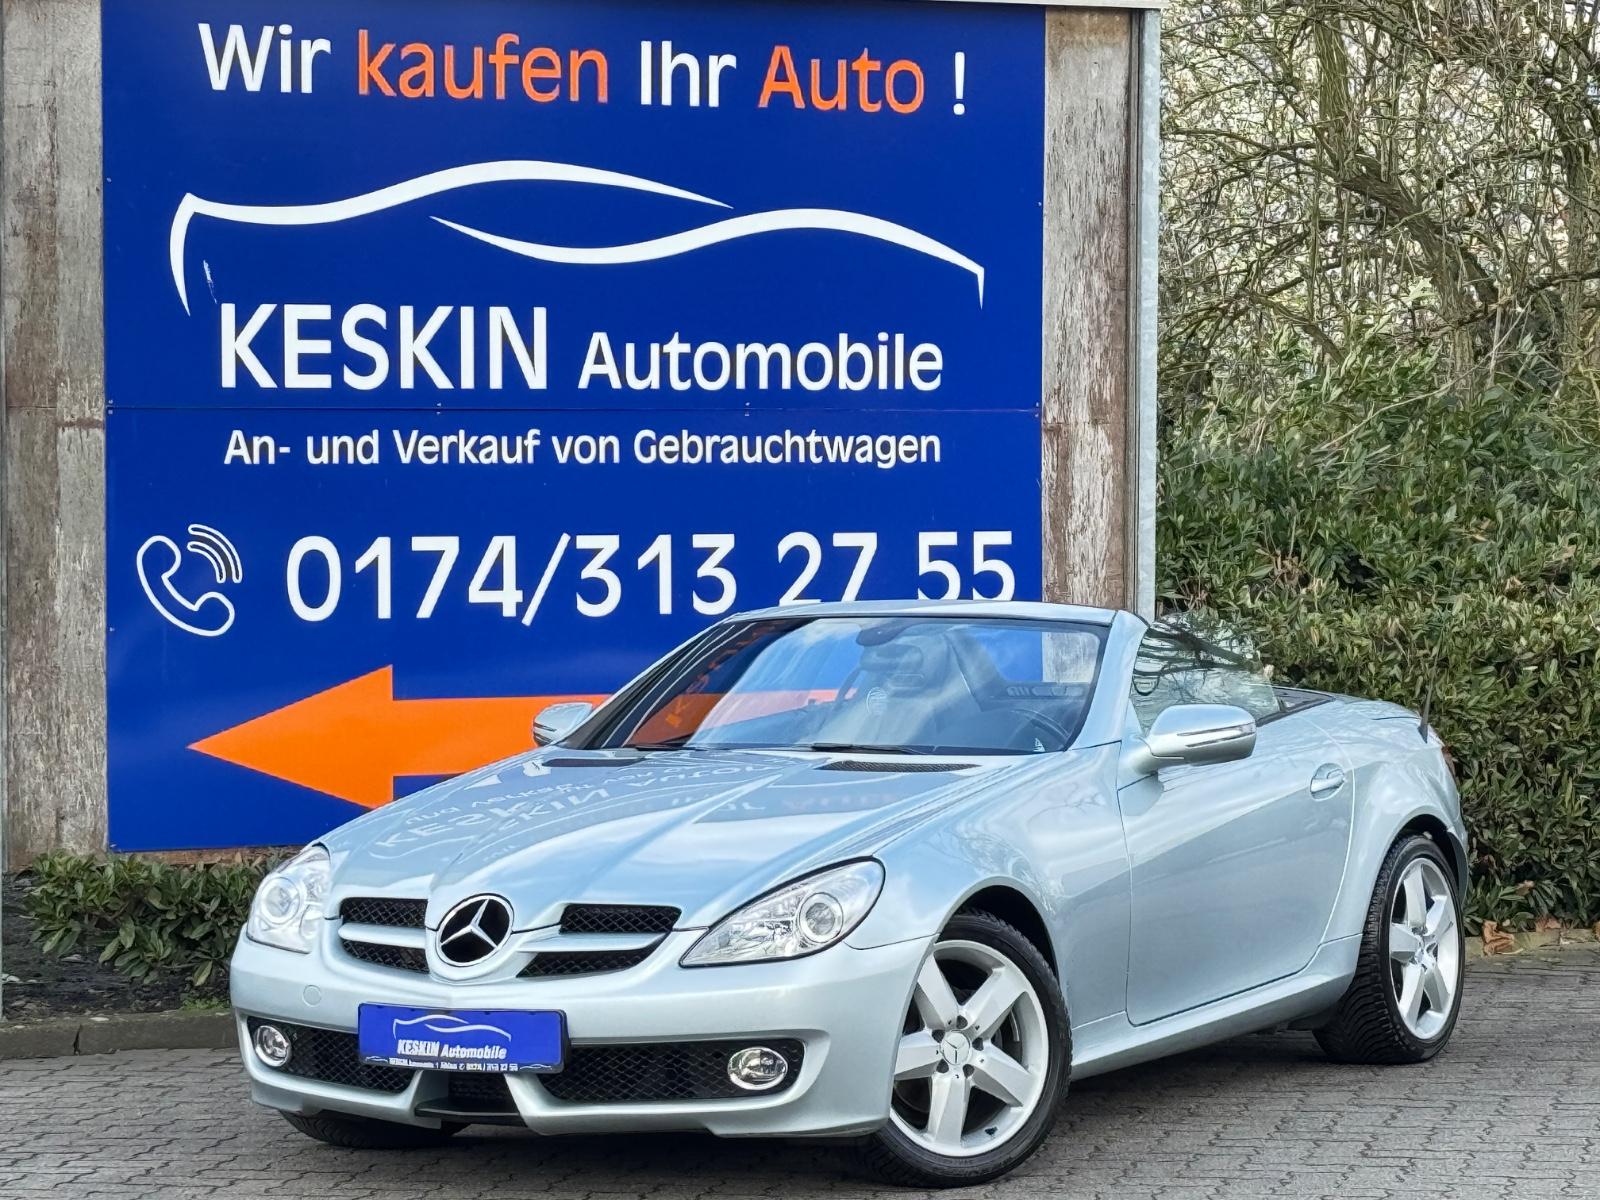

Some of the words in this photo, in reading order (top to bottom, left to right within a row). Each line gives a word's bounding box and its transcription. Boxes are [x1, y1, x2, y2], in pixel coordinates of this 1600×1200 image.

[198, 23, 332, 94] Wir
[358, 29, 609, 104] kaufen
[640, 41, 737, 108] Ihr
[758, 46, 926, 114] Auto
[952, 51, 966, 116] !
[220, 302, 547, 390] KESKIN
[577, 331, 944, 391] Automobile
[223, 429, 291, 465] An-
[306, 429, 379, 465] und
[392, 429, 541, 465] Verkauf
[551, 435, 620, 465] von
[633, 429, 941, 469] Gebrauchtwagen
[286, 532, 738, 626] 0174/313
[777, 531, 878, 607] 27
[917, 530, 1016, 602] 55
[397, 1039, 440, 1056] KESKIN
[440, 1043, 507, 1060] Automobile
